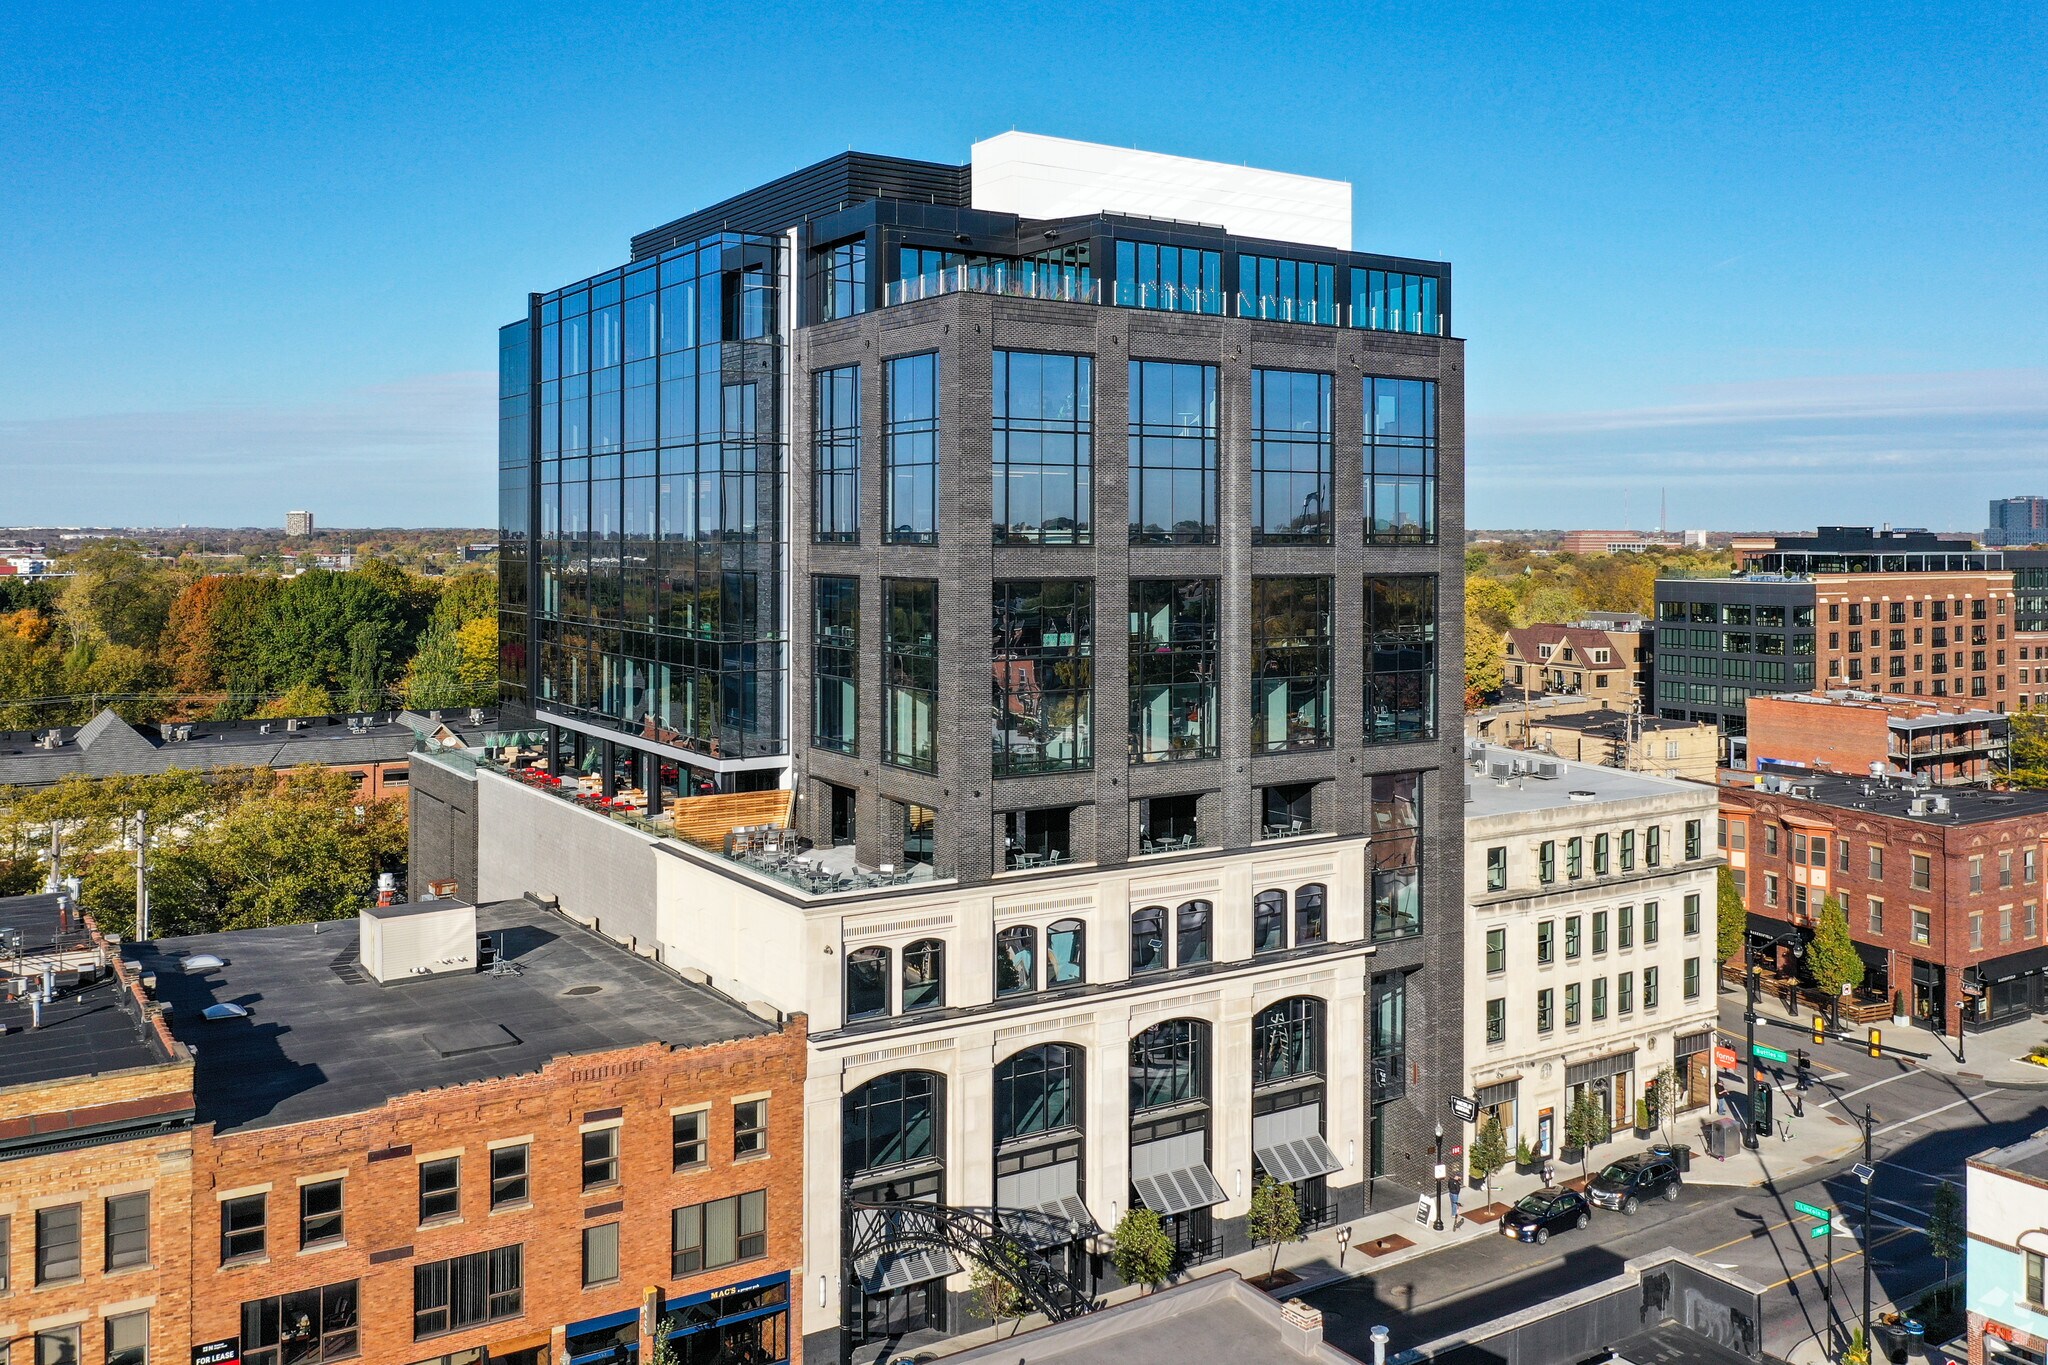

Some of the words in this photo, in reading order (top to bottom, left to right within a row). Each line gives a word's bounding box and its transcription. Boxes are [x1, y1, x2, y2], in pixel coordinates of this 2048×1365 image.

[1716, 1051, 1735, 1062] forno
[711, 1287, 736, 1299] MAC'S
[196, 1357, 211, 1365] FOR
[211, 1351, 234, 1362] LEASE
